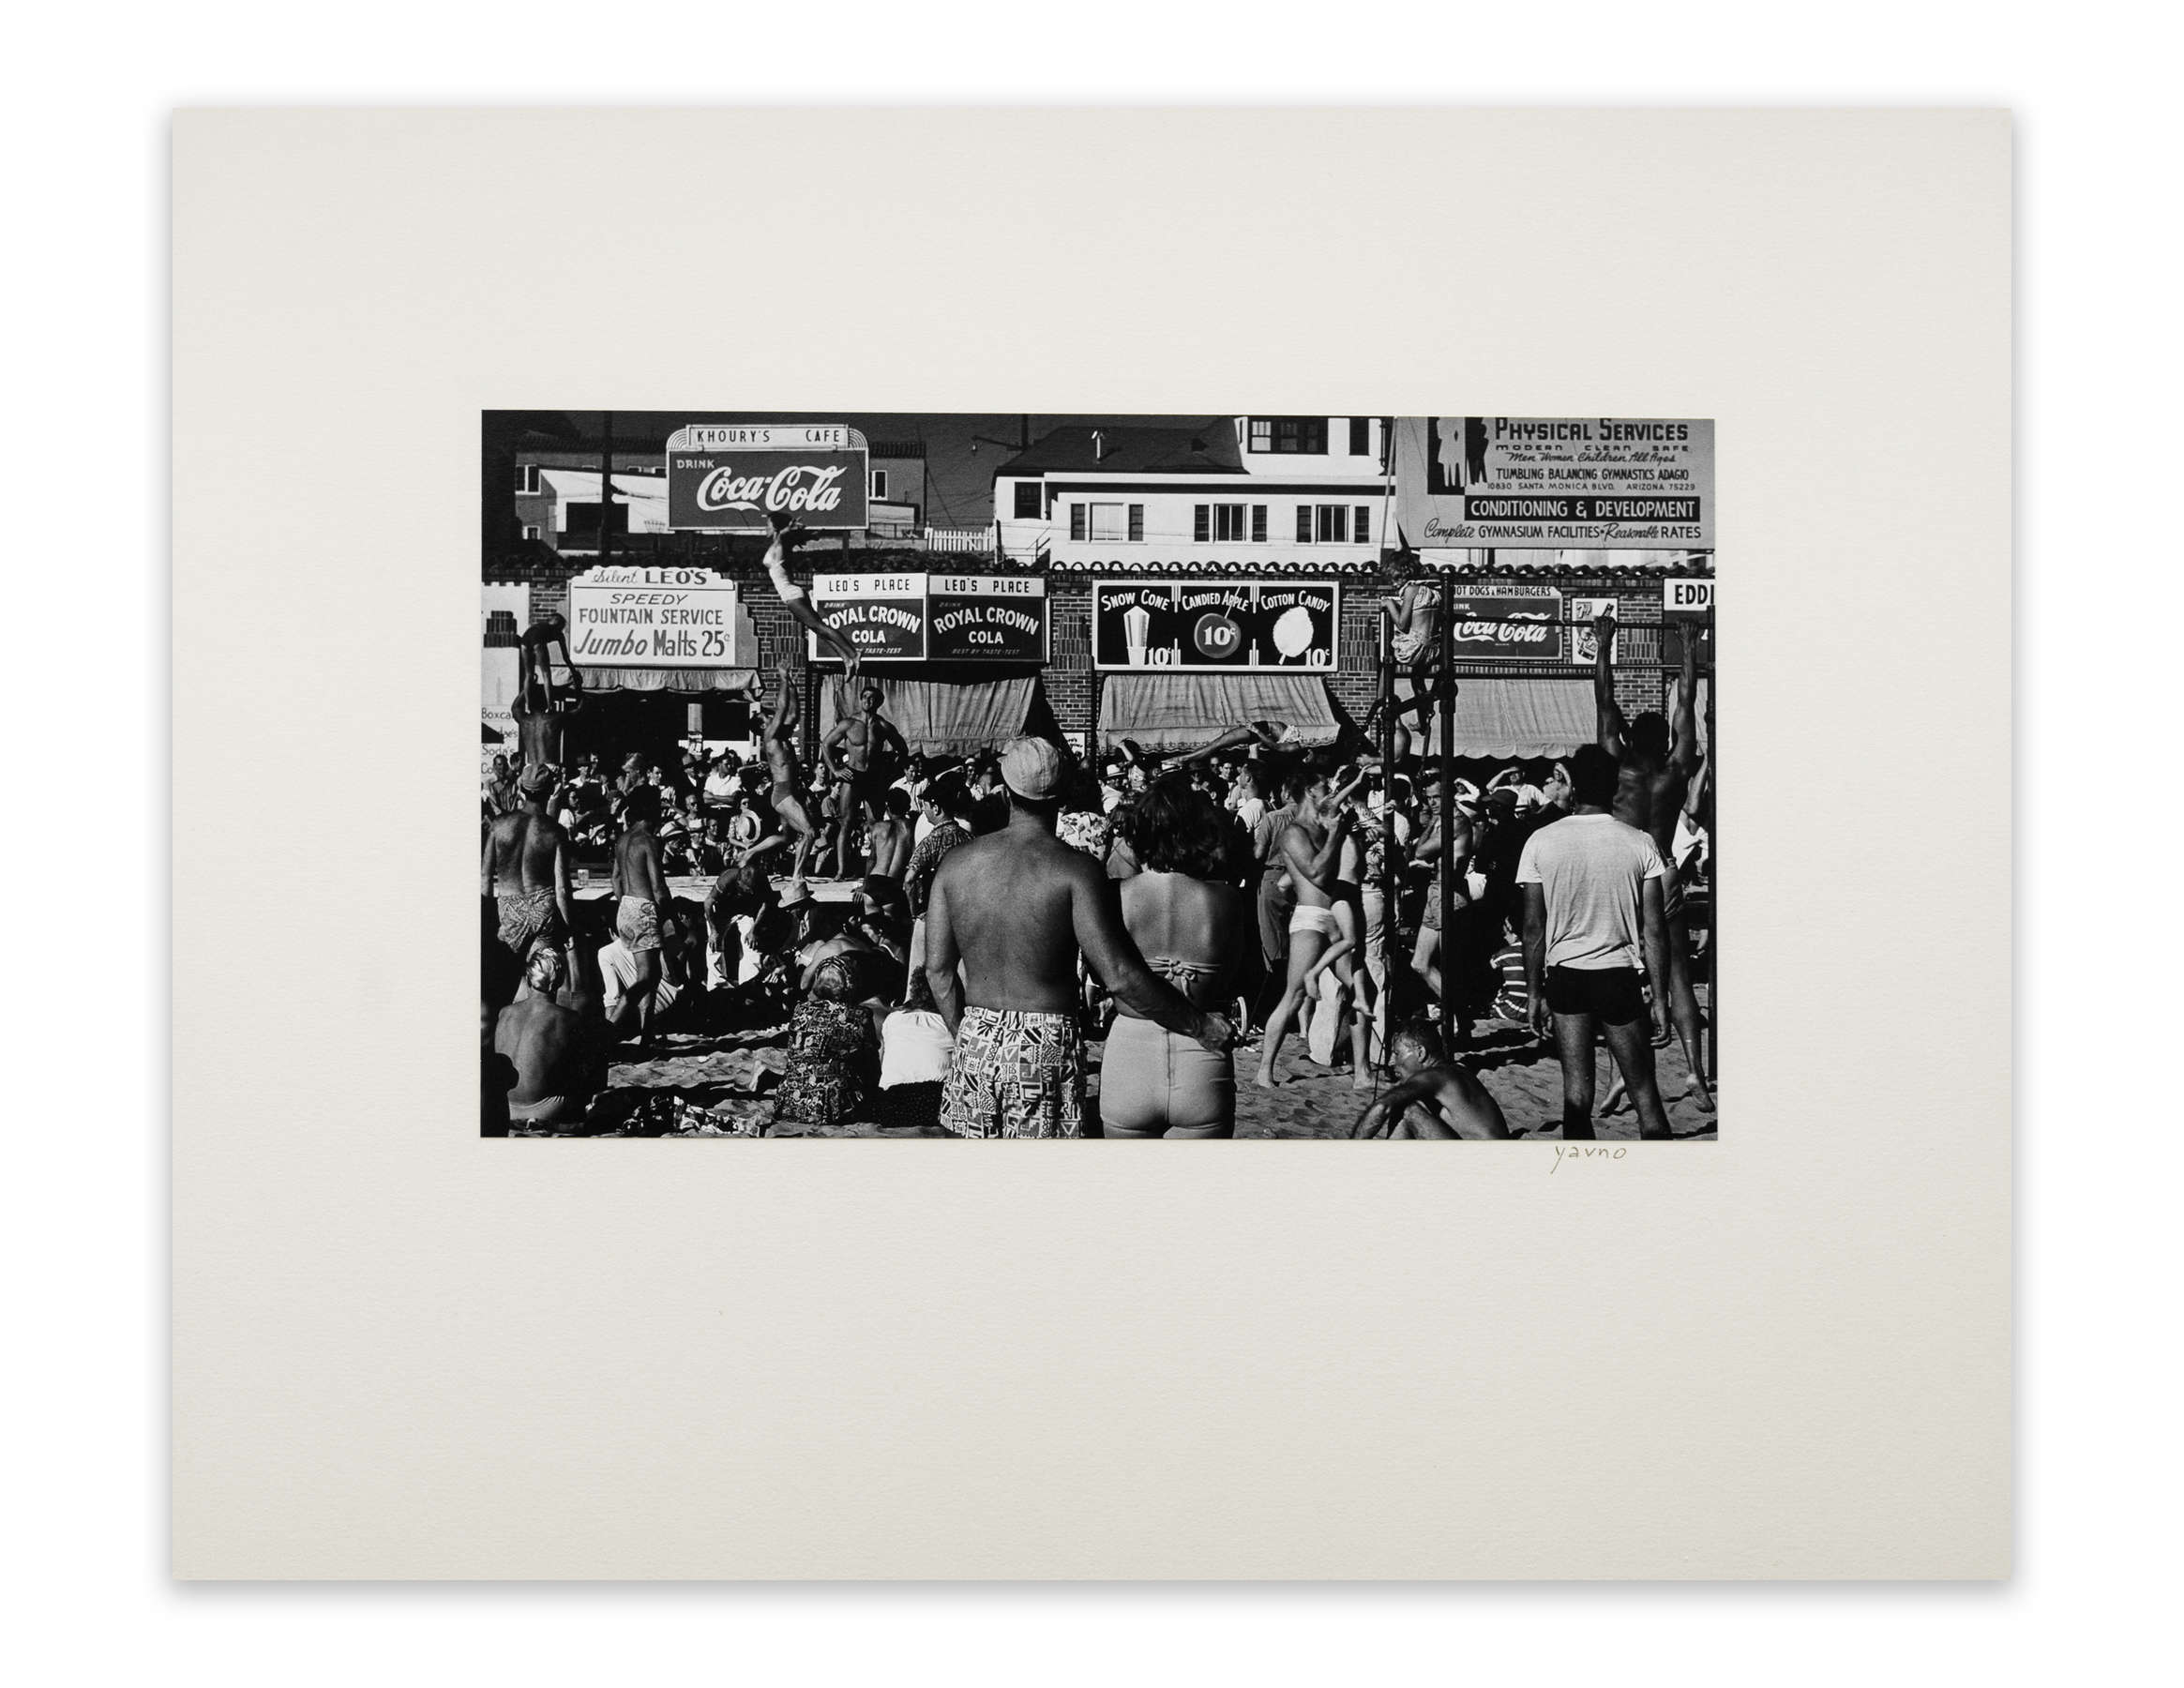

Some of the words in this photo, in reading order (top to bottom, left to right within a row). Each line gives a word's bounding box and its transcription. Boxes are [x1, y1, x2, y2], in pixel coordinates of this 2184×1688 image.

[697, 430, 771, 443] KHOURY'S
[806, 430, 840, 443] CAFE
[1495, 417, 1593, 441] PHYSICAL
[1599, 418, 1688, 442] SERVICES
[676, 459, 715, 469] DRINK
[1504, 451, 1537, 462] Men
[1538, 451, 1574, 462] Women
[1576, 451, 1628, 463] Children
[1628, 451, 1650, 462] All
[1649, 452, 1678, 467] Ages
[1496, 468, 1544, 480] TUMBLING
[1548, 469, 1598, 480] BALANCING
[1601, 468, 1655, 481] GYMNASTICS
[1657, 469, 1690, 481] ADAGIO
[696, 465, 848, 512] Coca-Cola
[1548, 482, 1589, 490] MONICA
[1470, 500, 1568, 517] CONDITIONING
[1575, 501, 1587, 519] &
[1595, 501, 1695, 518] DEVELOPMENT
[1423, 517, 1475, 544] Complete
[1478, 525, 1544, 538] GYMNASIUM
[1603, 522, 1659, 542] Reasonable
[1661, 526, 1702, 539] RATES
[591, 570, 639, 583] Silent
[644, 570, 707, 585] LEO'S
[829, 578, 860, 593] LEO'S
[874, 579, 911, 591] PLACE
[944, 577, 978, 593] LEO'S
[993, 580, 1031, 594] PLACE
[610, 593, 688, 606] SPEEDY
[1454, 586, 1468, 596] OT
[1469, 586, 1491, 596] DOGS
[1497, 586, 1552, 597] HAMBURGERS
[1101, 593, 1136, 611] SNOW
[1140, 589, 1171, 611] CONE
[1182, 593, 1221, 611] CANDIED
[1221, 590, 1250, 612] APPLE
[1260, 593, 1296, 610] COTTON
[1298, 589, 1332, 613] CANDY
[579, 608, 654, 625] FOUNTAIN
[660, 609, 724, 625] SERVICE
[868, 605, 922, 634] CROWN
[933, 607, 984, 635] ROYAL
[987, 606, 1040, 636] CROWN
[574, 628, 648, 656] Jumbo
[654, 629, 697, 657] Malts
[851, 629, 886, 644] COLA
[968, 630, 1004, 645] COLA
[481, 707, 512, 719] Boxca
